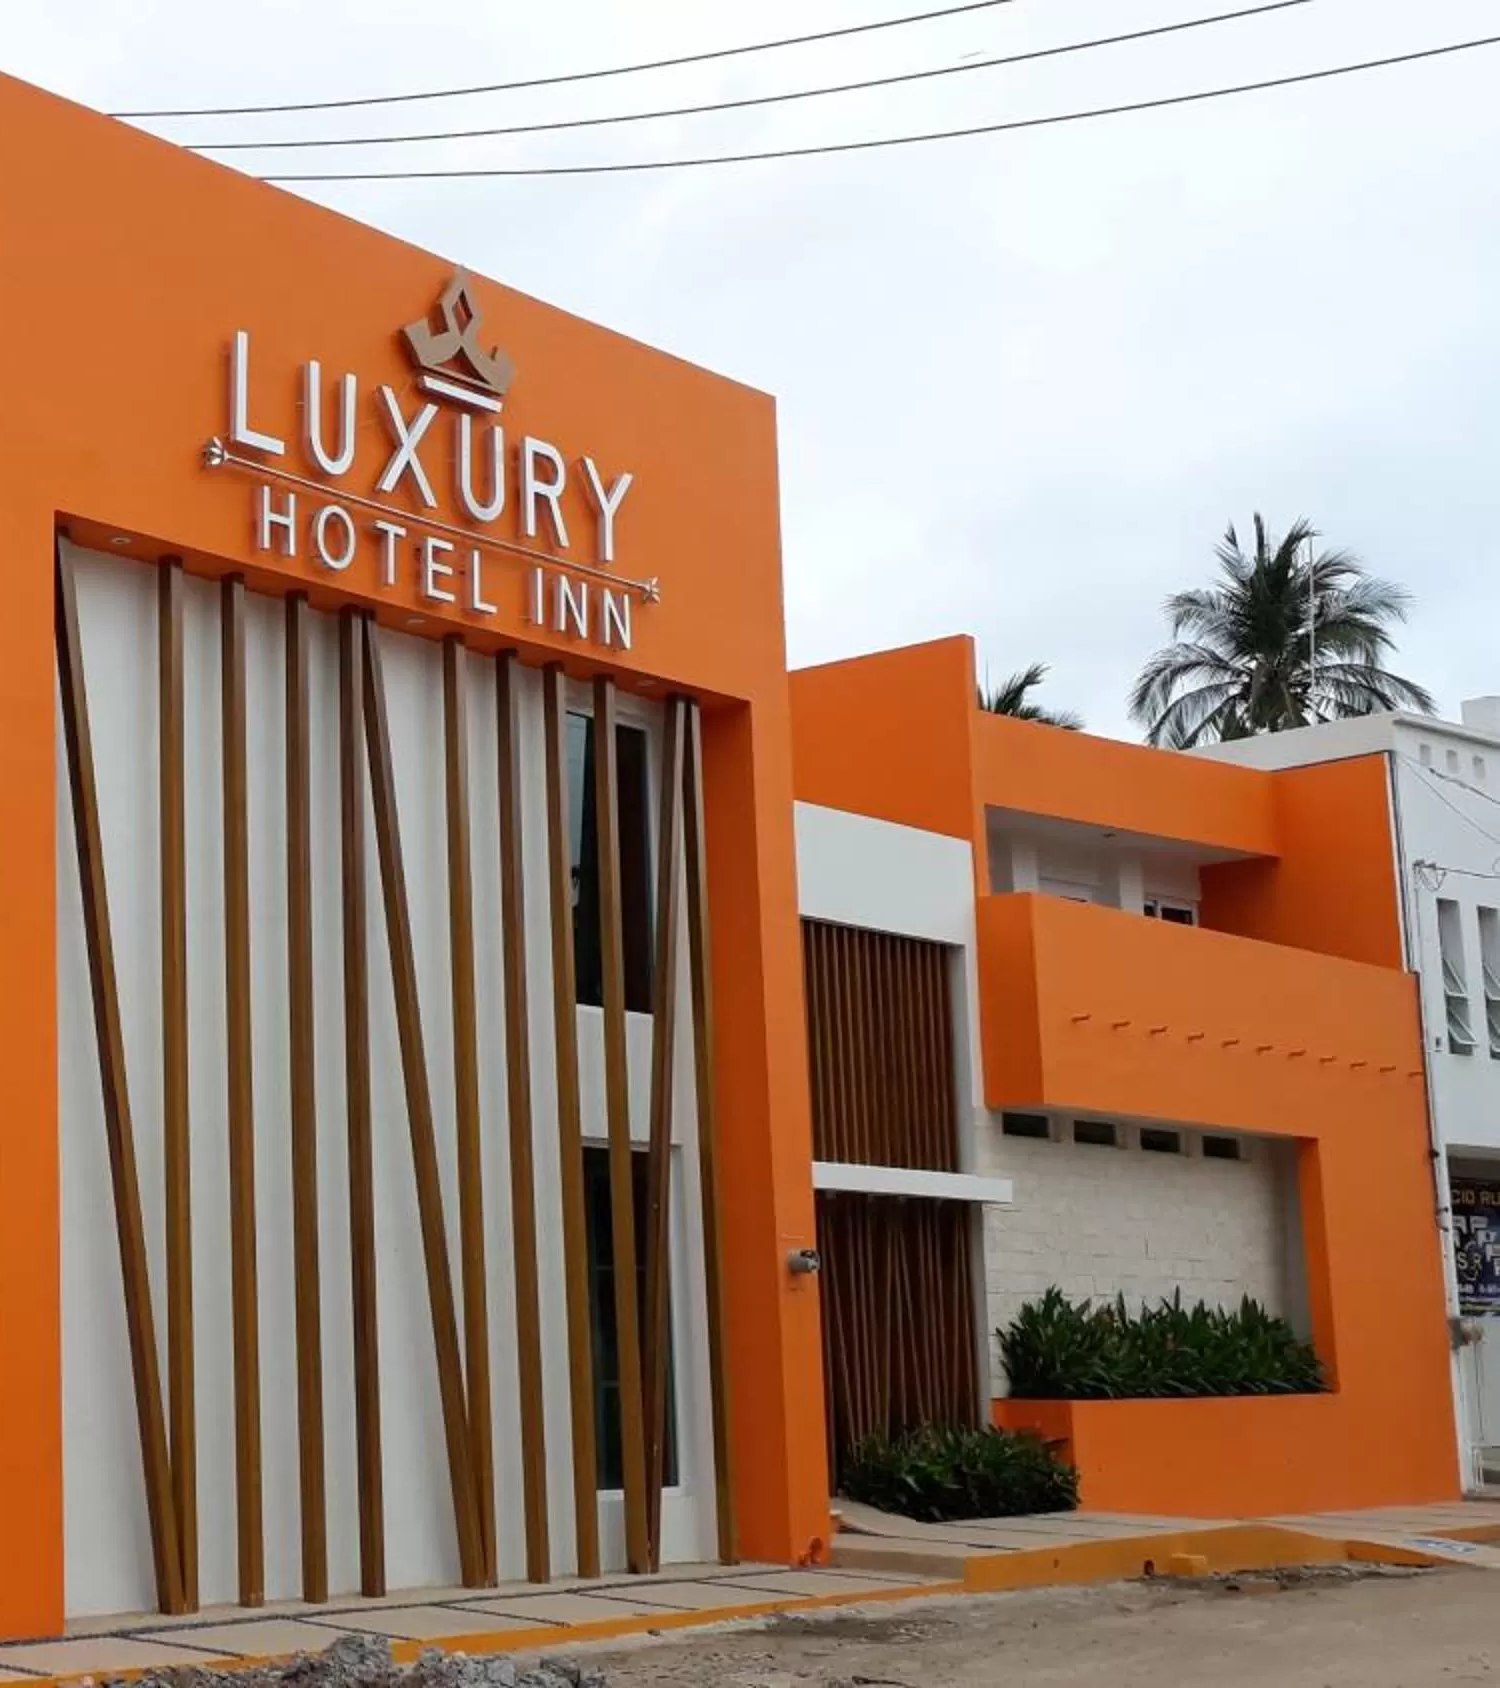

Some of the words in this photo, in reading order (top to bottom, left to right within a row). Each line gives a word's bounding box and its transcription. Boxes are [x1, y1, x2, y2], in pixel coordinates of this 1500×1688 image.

[230, 330, 633, 562] LUXURY
[258, 485, 498, 614] HOTEL
[531, 567, 632, 651] INN
